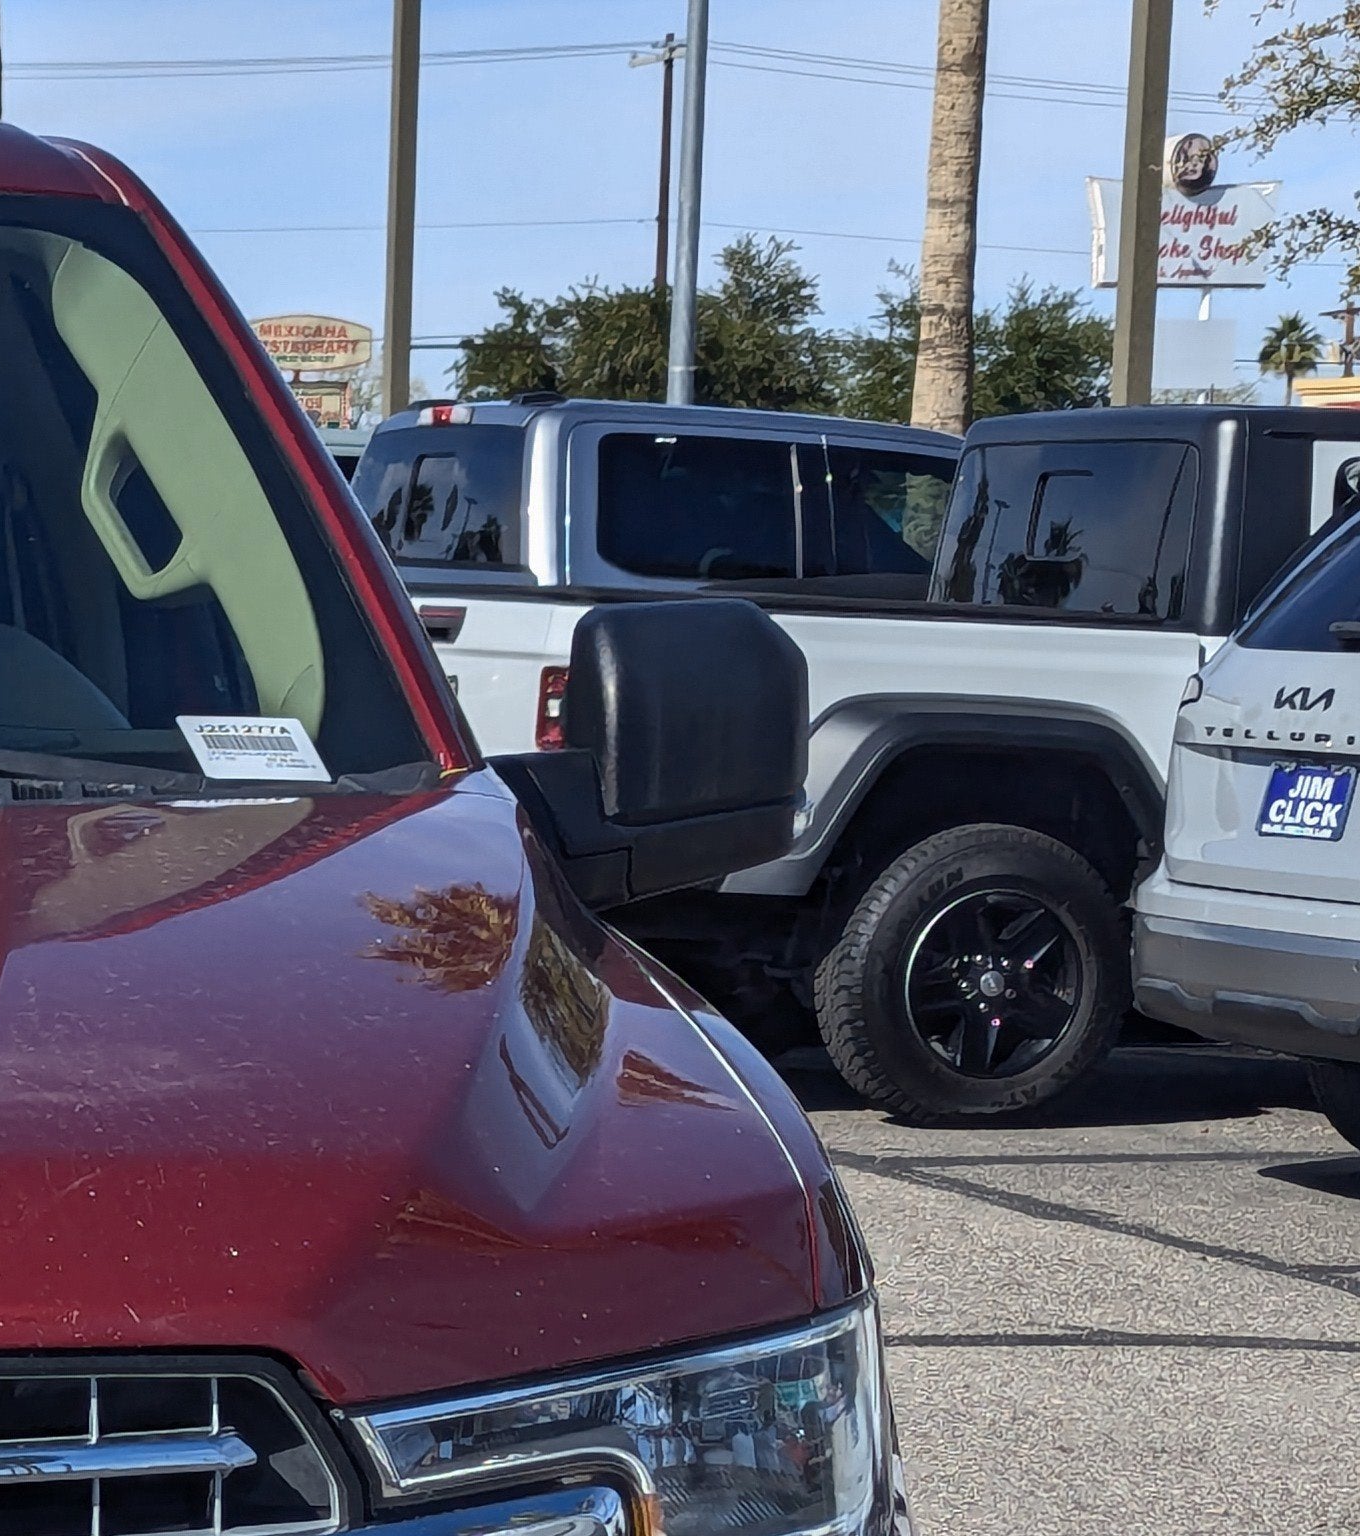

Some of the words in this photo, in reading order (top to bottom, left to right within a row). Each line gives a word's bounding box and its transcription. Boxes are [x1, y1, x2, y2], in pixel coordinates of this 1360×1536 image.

[1160, 203, 1238, 233] elightful
[259, 323, 348, 339] MEXICANA
[263, 339, 360, 354] STAURANT
[1288, 775, 1336, 801] JIM
[1268, 799, 1343, 828] CLICK
